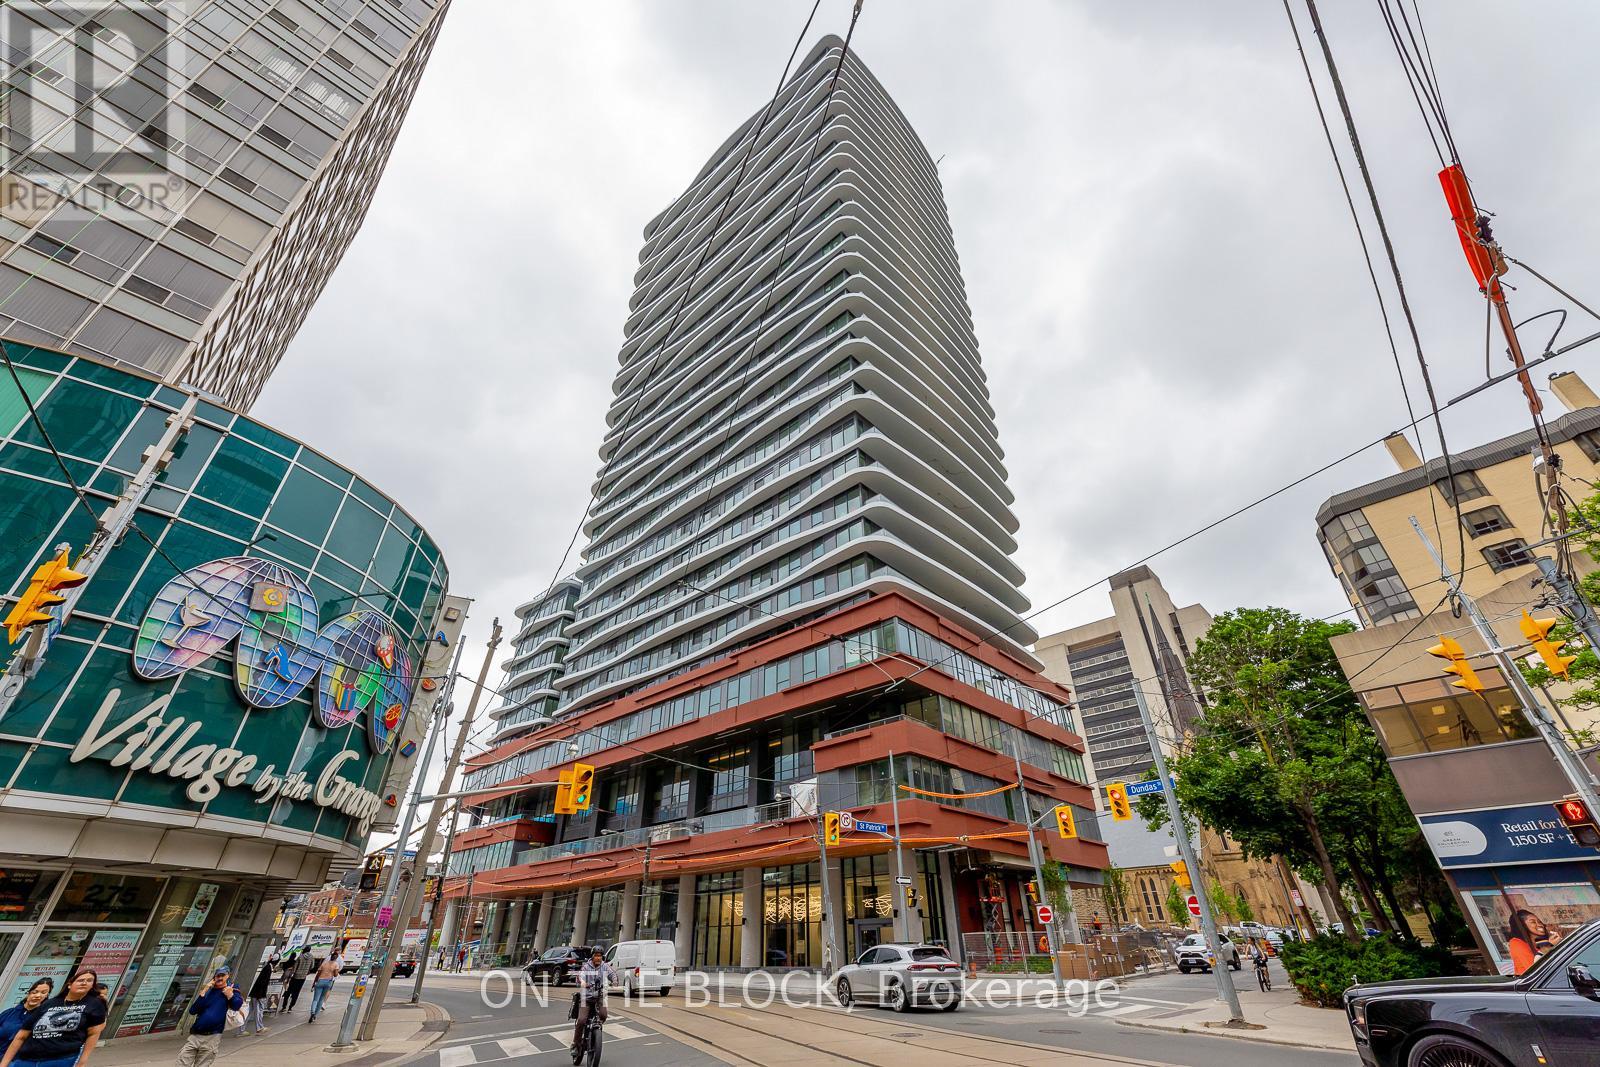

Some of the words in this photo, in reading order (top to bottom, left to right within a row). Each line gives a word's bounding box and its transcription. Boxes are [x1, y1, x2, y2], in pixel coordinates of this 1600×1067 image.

[70, 688, 258, 802] Village
[252, 764, 281, 804] by
[281, 770, 312, 801] the
[314, 749, 383, 838] Grange
[1130, 783, 1157, 794] Dundas
[865, 823, 882, 831] Patrick
[1501, 820, 1538, 834] Retail
[1538, 819, 1557, 830] for
[1507, 834, 1537, 848] 1,150
[1537, 832, 1555, 844] SF
[92, 941, 111, 949] NOW
[111, 941, 132, 949] OPEN
